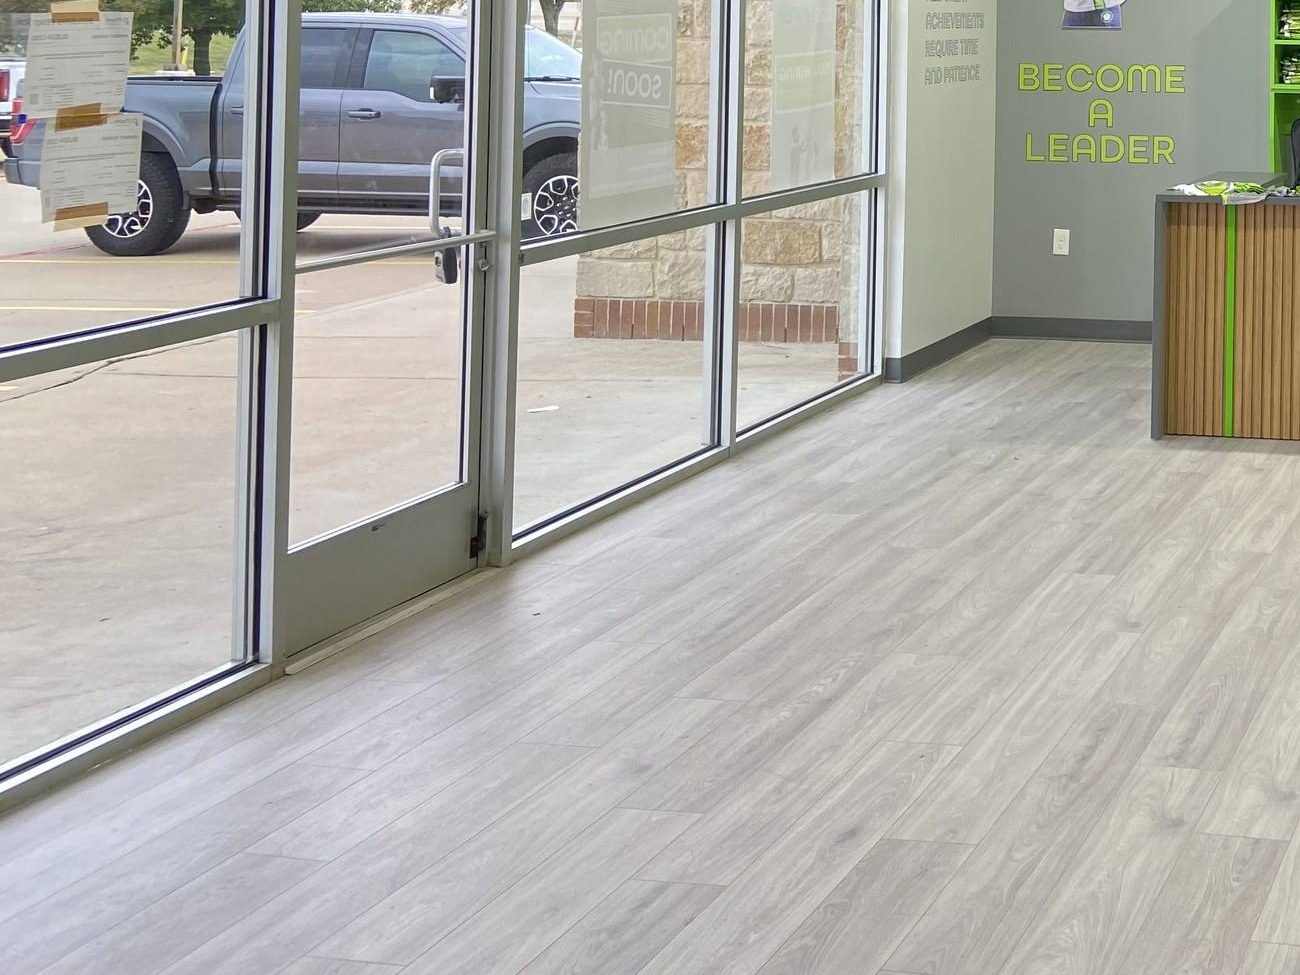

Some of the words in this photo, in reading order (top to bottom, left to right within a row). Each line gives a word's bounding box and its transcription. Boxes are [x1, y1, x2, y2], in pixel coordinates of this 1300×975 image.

[1017, 62, 1186, 93] BECOME
[1088, 97, 1114, 128] A
[1024, 132, 1177, 165] LEADER
